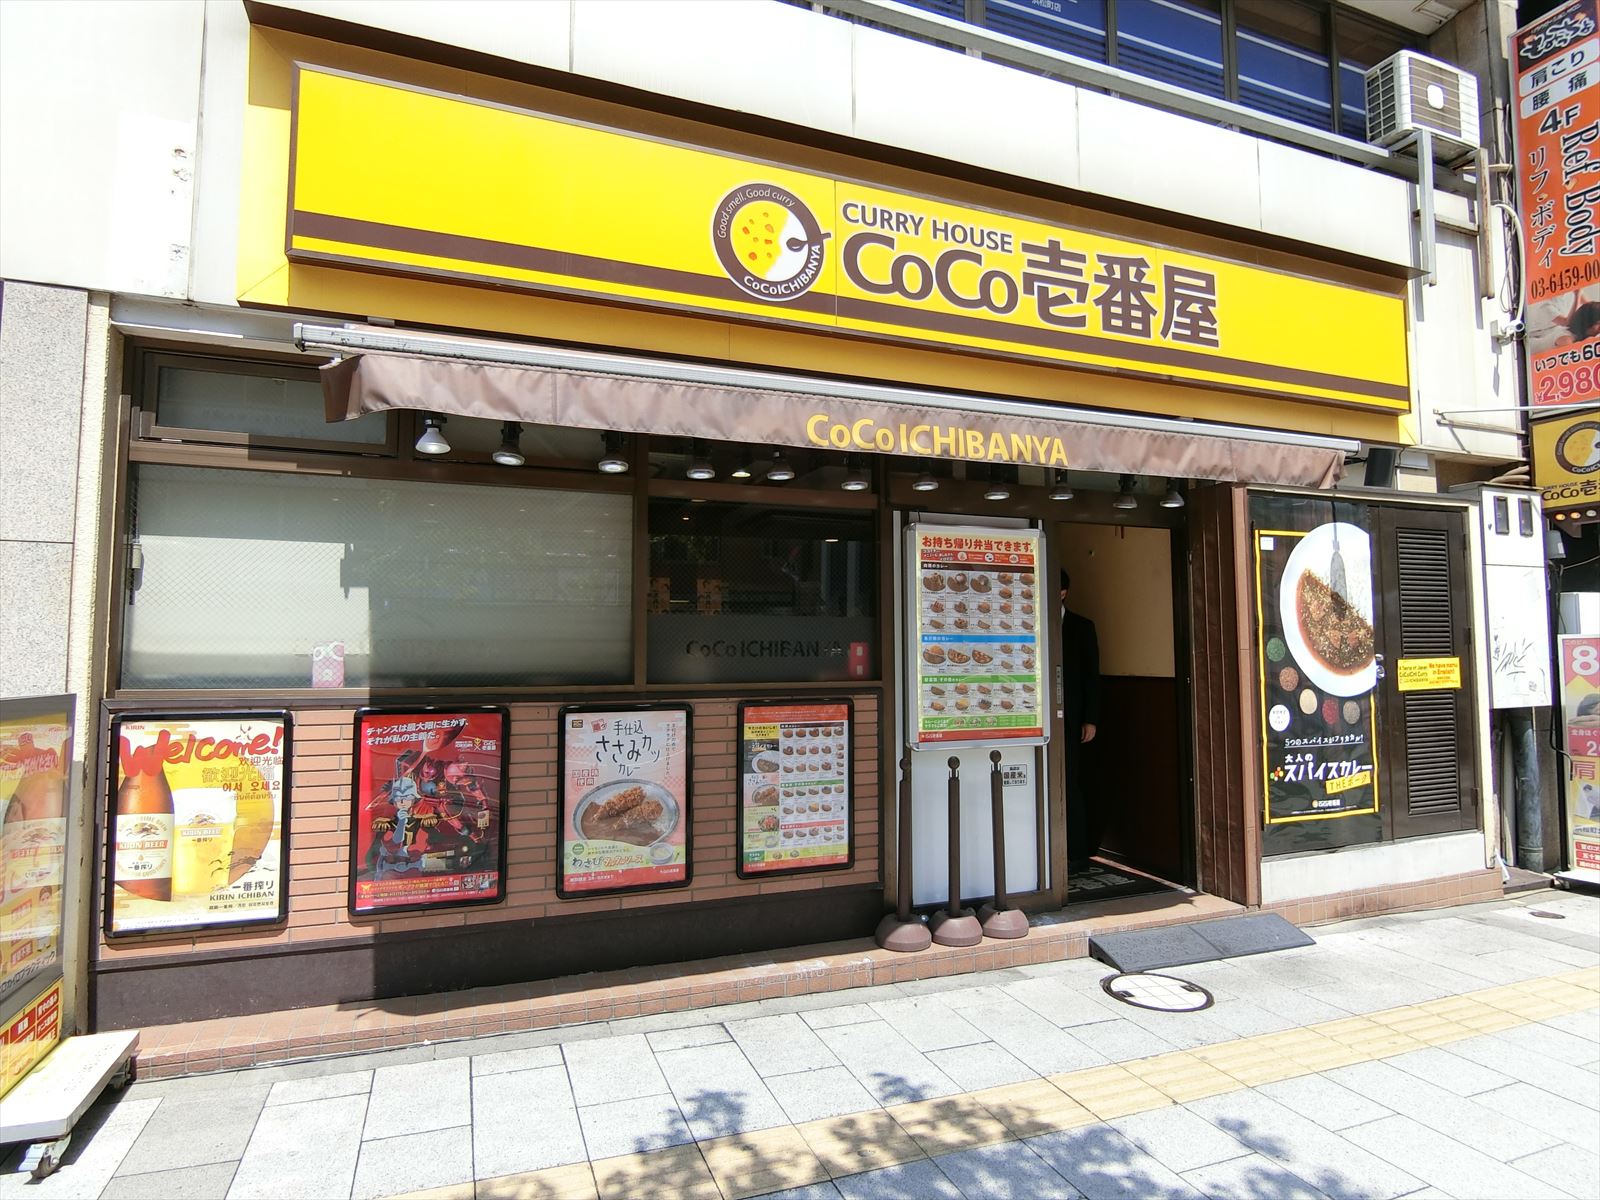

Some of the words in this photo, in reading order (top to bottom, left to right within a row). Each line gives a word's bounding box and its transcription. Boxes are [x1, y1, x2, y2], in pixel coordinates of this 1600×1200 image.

[1530, 50, 1585, 89] 肩こり
[1540, 105, 1579, 133] 4F
[717, 211, 730, 238] Good
[746, 188, 771, 198] Good
[771, 191, 796, 207] curry
[842, 203, 924, 236] CURRY
[932, 219, 1013, 254] HOUSE
[1541, 479, 1600, 500] CoCo壱
[613, 719, 643, 736] 手仕込
[119, 726, 284, 778] Welcome!
[595, 735, 660, 763] ささみカツ
[1284, 753, 1313, 763] 大人の
[618, 763, 641, 777] カレー
[1284, 759, 1373, 782] スパイスカレー
[222, 782, 242, 792] 어서
[250, 781, 280, 791] 오세요
[209, 893, 235, 901] KIRIN
[238, 891, 274, 900] ICHIBAN
[231, 880, 274, 891] 一番搾り
